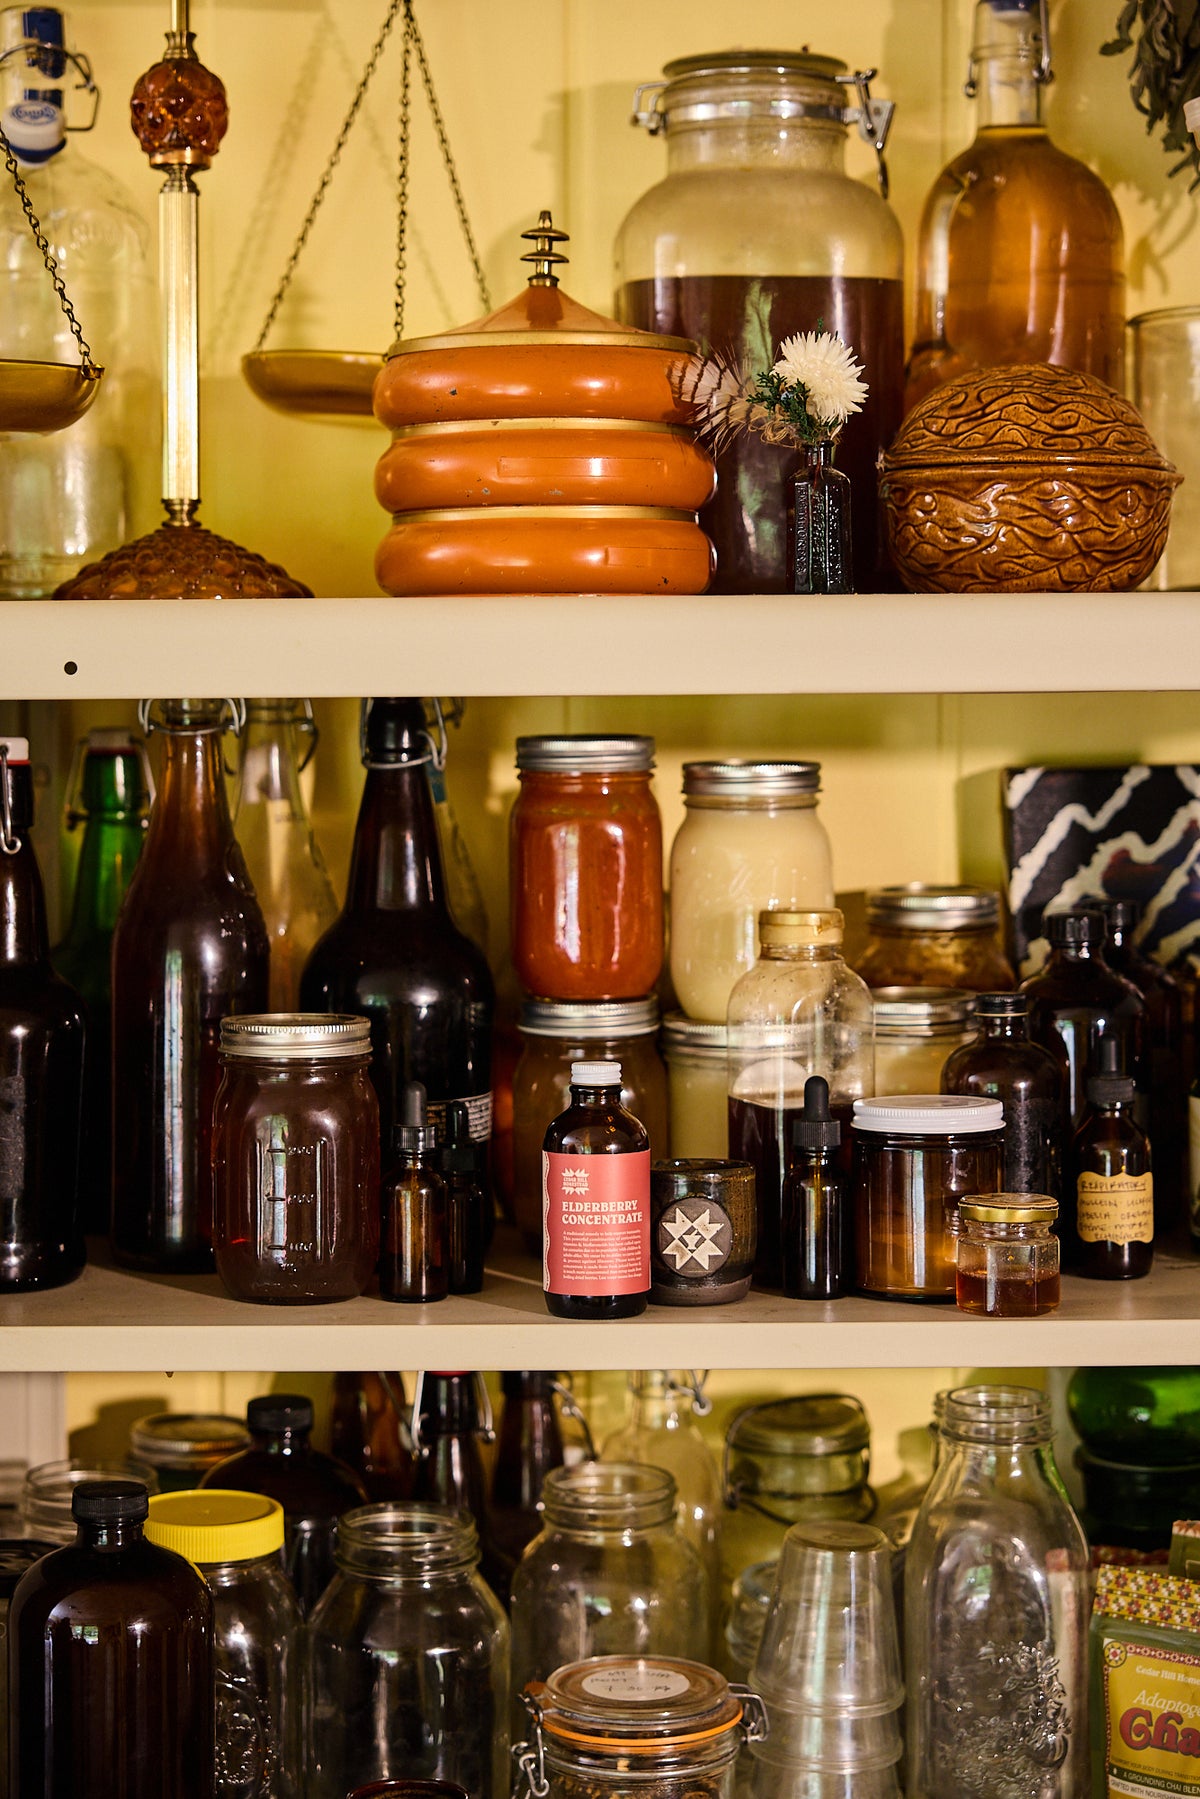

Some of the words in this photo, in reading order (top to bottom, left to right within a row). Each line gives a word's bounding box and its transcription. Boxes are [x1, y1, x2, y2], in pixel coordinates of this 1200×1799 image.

[562, 1200, 638, 1212] ELDERBERRY
[562, 1212, 642, 1225] CONCENTRATE
[1136, 1666, 1160, 1677] Cedar
[1161, 1670, 1176, 1680] Hill
[1128, 1772, 1166, 1788] GROUNDING
[1166, 1781, 1182, 1791] CHAI
[1130, 1786, 1144, 1795] WITH
